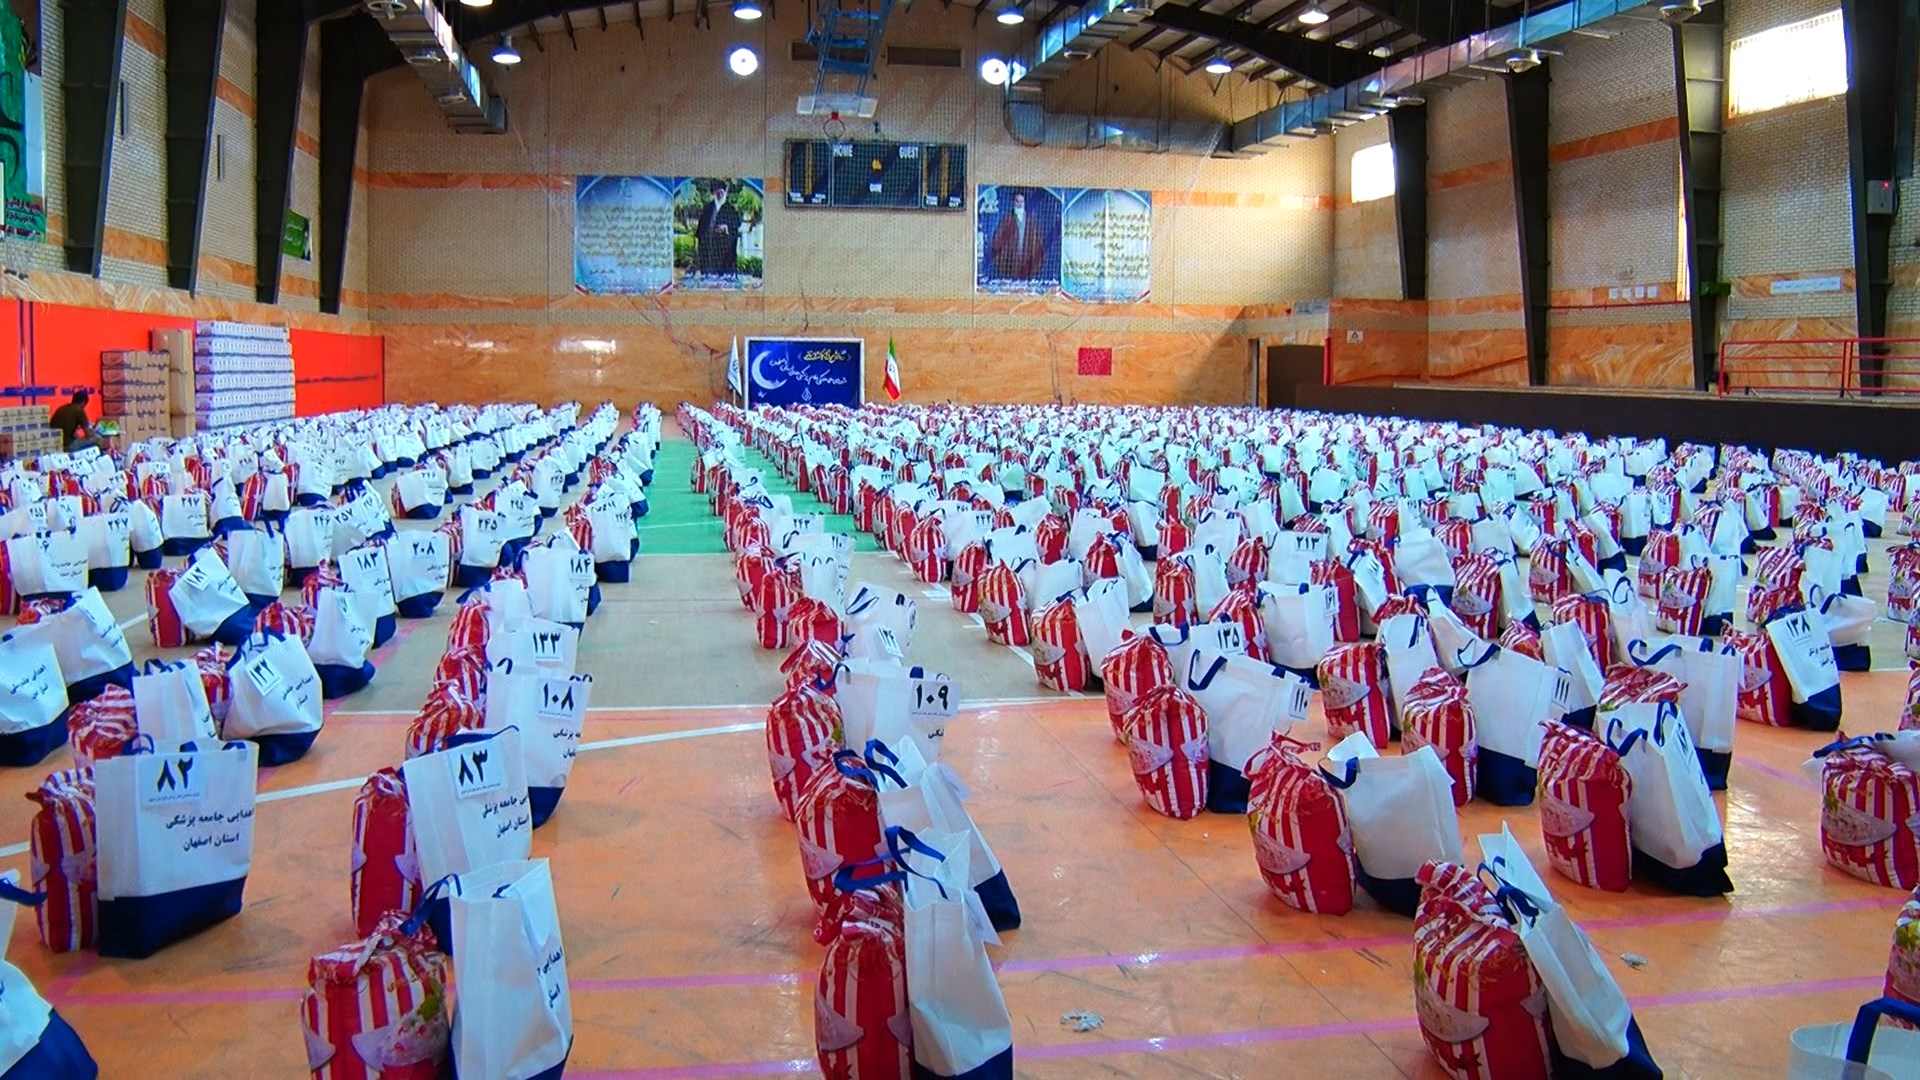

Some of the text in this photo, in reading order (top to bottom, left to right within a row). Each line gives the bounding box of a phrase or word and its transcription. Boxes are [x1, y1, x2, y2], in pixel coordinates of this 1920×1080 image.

[478, 517, 498, 531] ۲۴۵
[412, 541, 436, 556] ۲۰۸
[1296, 535, 1320, 550] ۲۱۳
[570, 557, 592, 574] ۱۸۴
[532, 631, 562, 655] ۱۳۳
[1217, 626, 1241, 650] ۱۳۵
[249, 657, 276, 687] ۱۳۲
[543, 681, 575, 712] ۱۰۸
[915, 683, 949, 711] ۱۰۹
[1294, 687, 1309, 713] ۱۱۰
[1554, 676, 1571, 705] ۱۱۱
[156, 755, 194, 793] ۸۲
[458, 748, 489, 788] ۸۳
[165, 813, 195, 830] پزشکی
[198, 810, 224, 824] جامعه
[182, 831, 240, 852] استان اصفهان
